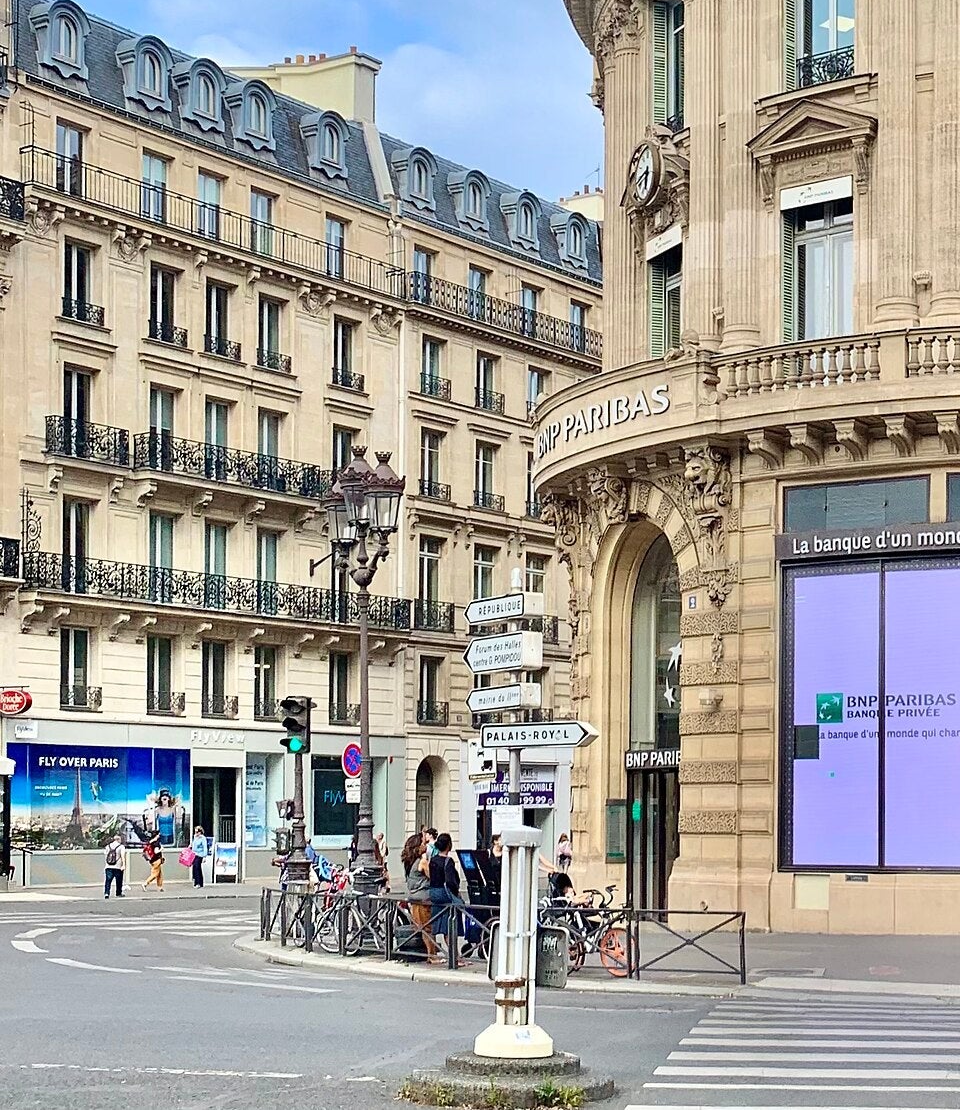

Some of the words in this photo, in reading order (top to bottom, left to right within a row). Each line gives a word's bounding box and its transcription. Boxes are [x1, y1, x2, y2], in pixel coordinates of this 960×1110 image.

[536, 421, 561, 459] BNP
[561, 384, 671, 442] PARIBAS
[792, 537, 809, 554] La
[814, 535, 871, 555] banque
[875, 531, 912, 550] d'un
[478, 600, 521, 616] RÉPUBLIQUE
[475, 644, 492, 655] Forum
[493, 642, 503, 652] des
[504, 640, 521, 650] Halles
[473, 658, 488, 667] centre
[493, 652, 522, 665] POMPIDOU
[846, 695, 878, 708] BNP
[885, 693, 957, 707] PARIBAS
[898, 706, 941, 718] PRIVÉE
[190, 730, 246, 745] FlyView
[819, 732, 826, 740] a
[827, 729, 859, 741] banque
[860, 729, 880, 739] d'un
[886, 728, 919, 738] monde
[921, 728, 937, 740] qui
[38, 756, 56, 767] FLY
[59, 756, 88, 767] OVER
[89, 758, 119, 768] PARIS
[625, 752, 648, 768] BNP
[486, 797, 496, 805] 01
[498, 796, 510, 805] 40
[523, 796, 534, 804] 99
